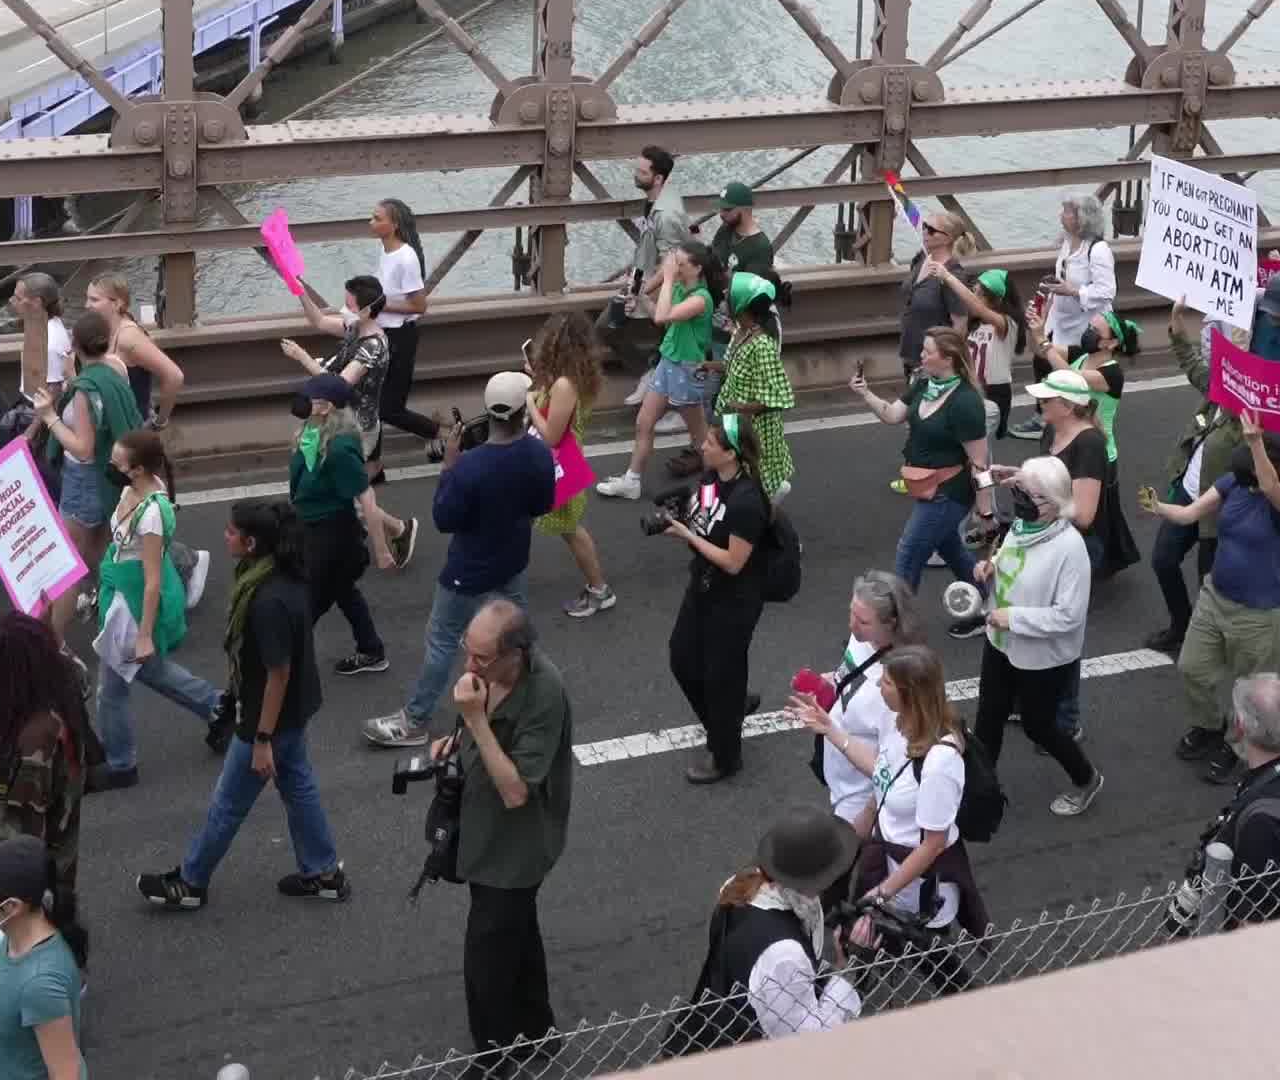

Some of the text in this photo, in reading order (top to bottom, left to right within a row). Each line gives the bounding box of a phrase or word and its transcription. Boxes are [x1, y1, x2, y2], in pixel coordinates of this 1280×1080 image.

[1162, 172, 1175, 190] IF
[1176, 179, 1194, 200] MEN
[1209, 190, 1254, 224] PREGNANT
[1152, 200, 1252, 250] YOU COULD GET AN
[1163, 226, 1239, 270] ABORTION
[1165, 253, 1182, 272] AT
[1186, 261, 1204, 283] AN
[1210, 270, 1244, 302] ATM
